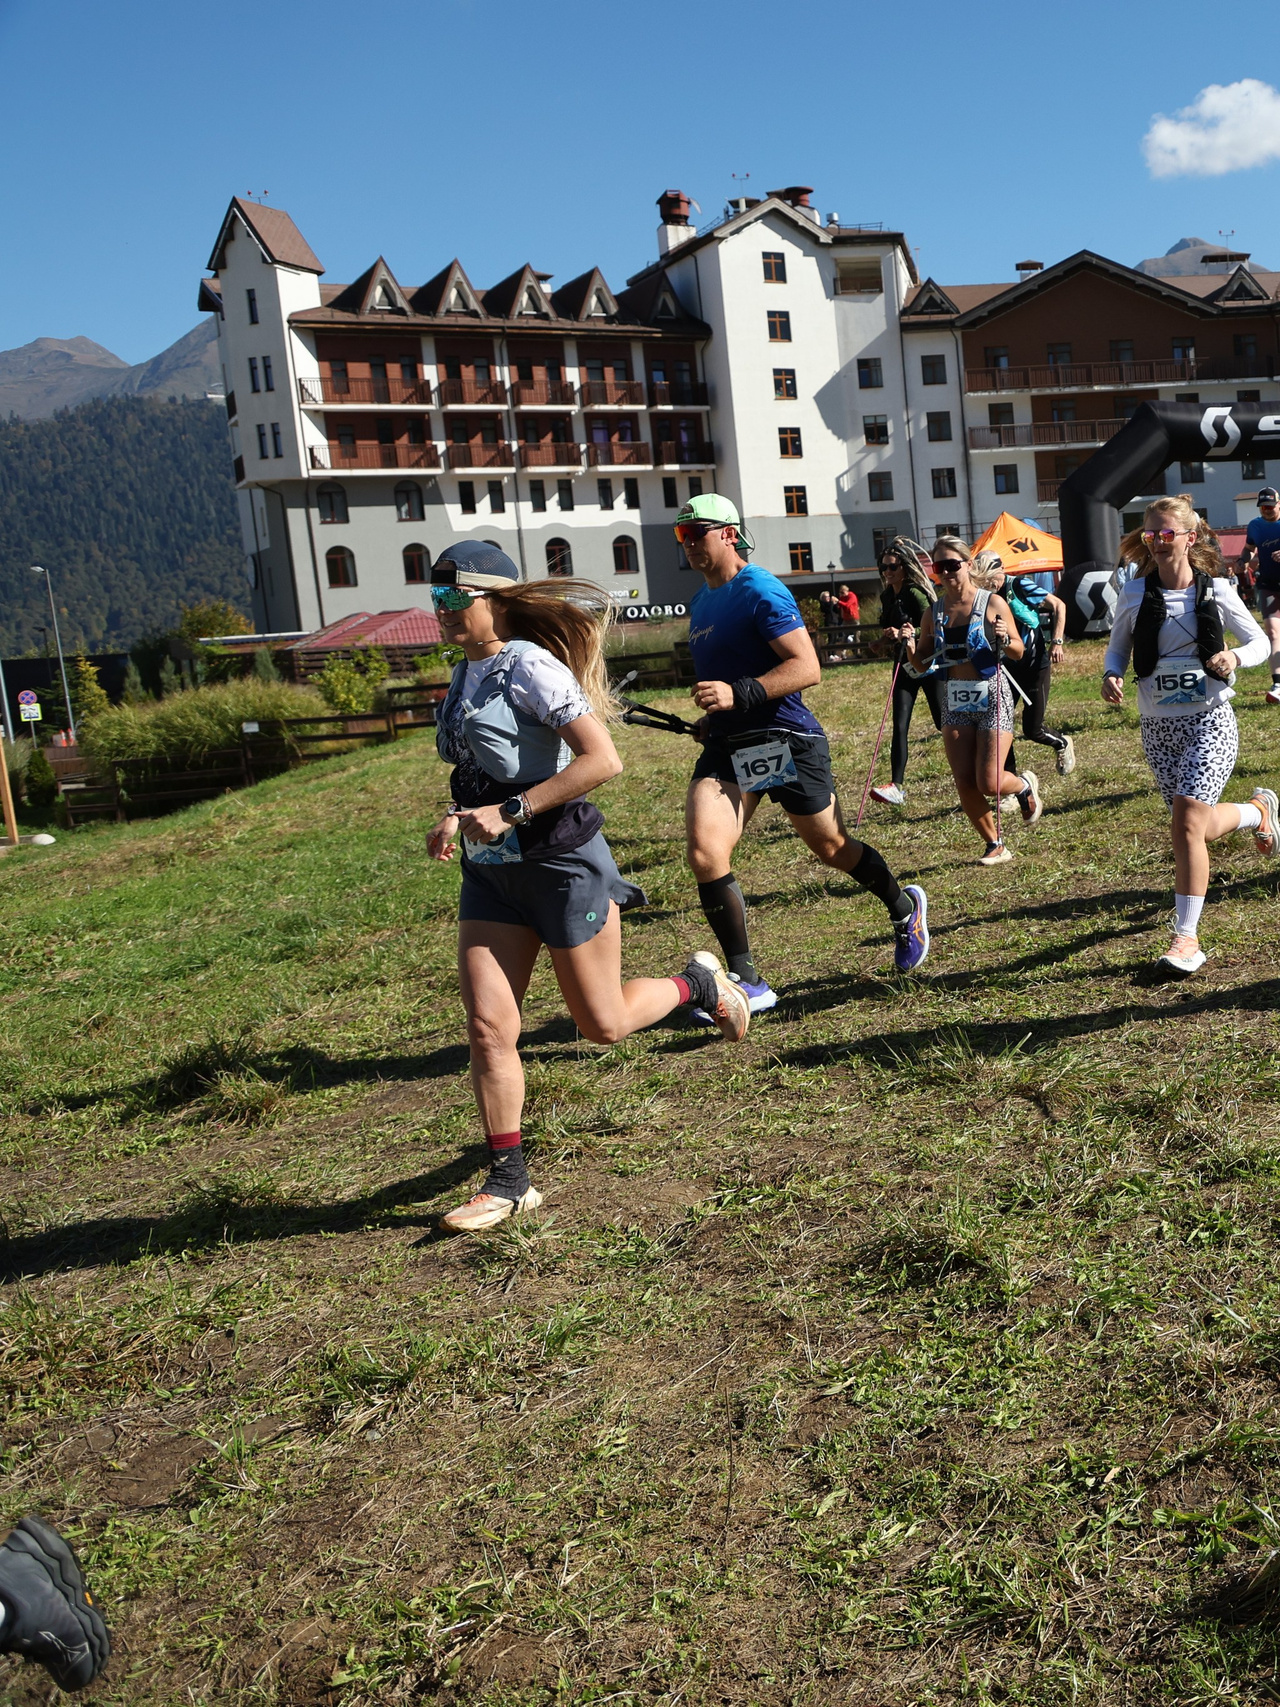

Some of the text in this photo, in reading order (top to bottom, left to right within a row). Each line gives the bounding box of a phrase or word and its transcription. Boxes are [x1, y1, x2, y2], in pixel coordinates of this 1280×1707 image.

[1155, 673, 1199, 691] 158
[952, 690, 982, 702] 137
[741, 754, 783, 778] 167
